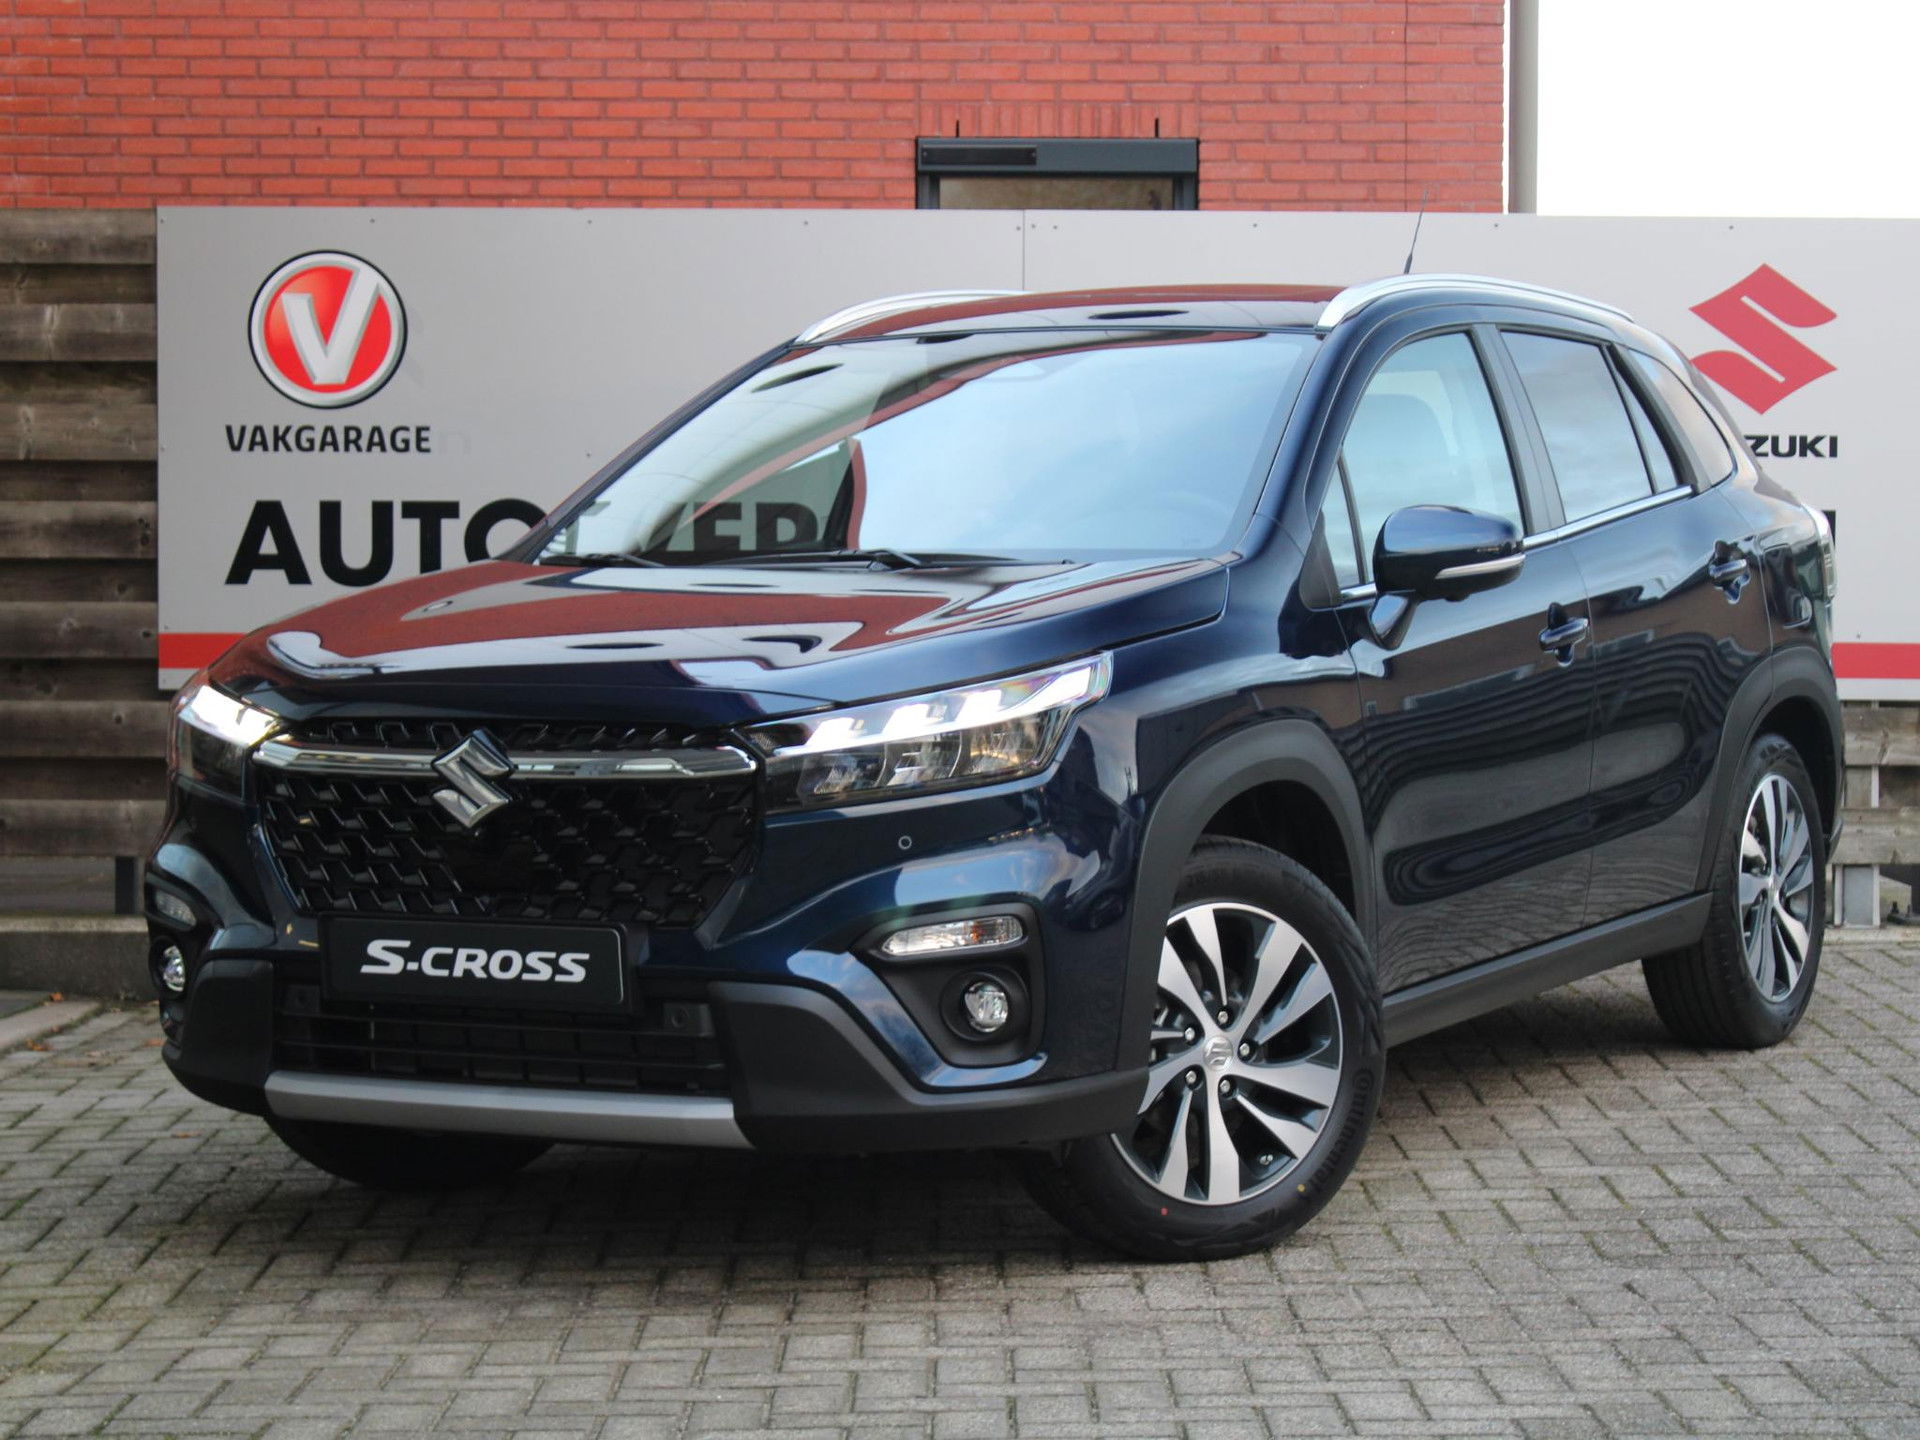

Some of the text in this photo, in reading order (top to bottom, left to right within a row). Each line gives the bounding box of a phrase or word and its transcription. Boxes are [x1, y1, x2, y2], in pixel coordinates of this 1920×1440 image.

[225, 425, 431, 453] VAKGARAGE
[1744, 435, 1838, 458] ZUKI
[360, 939, 590, 983] S-CROSS
